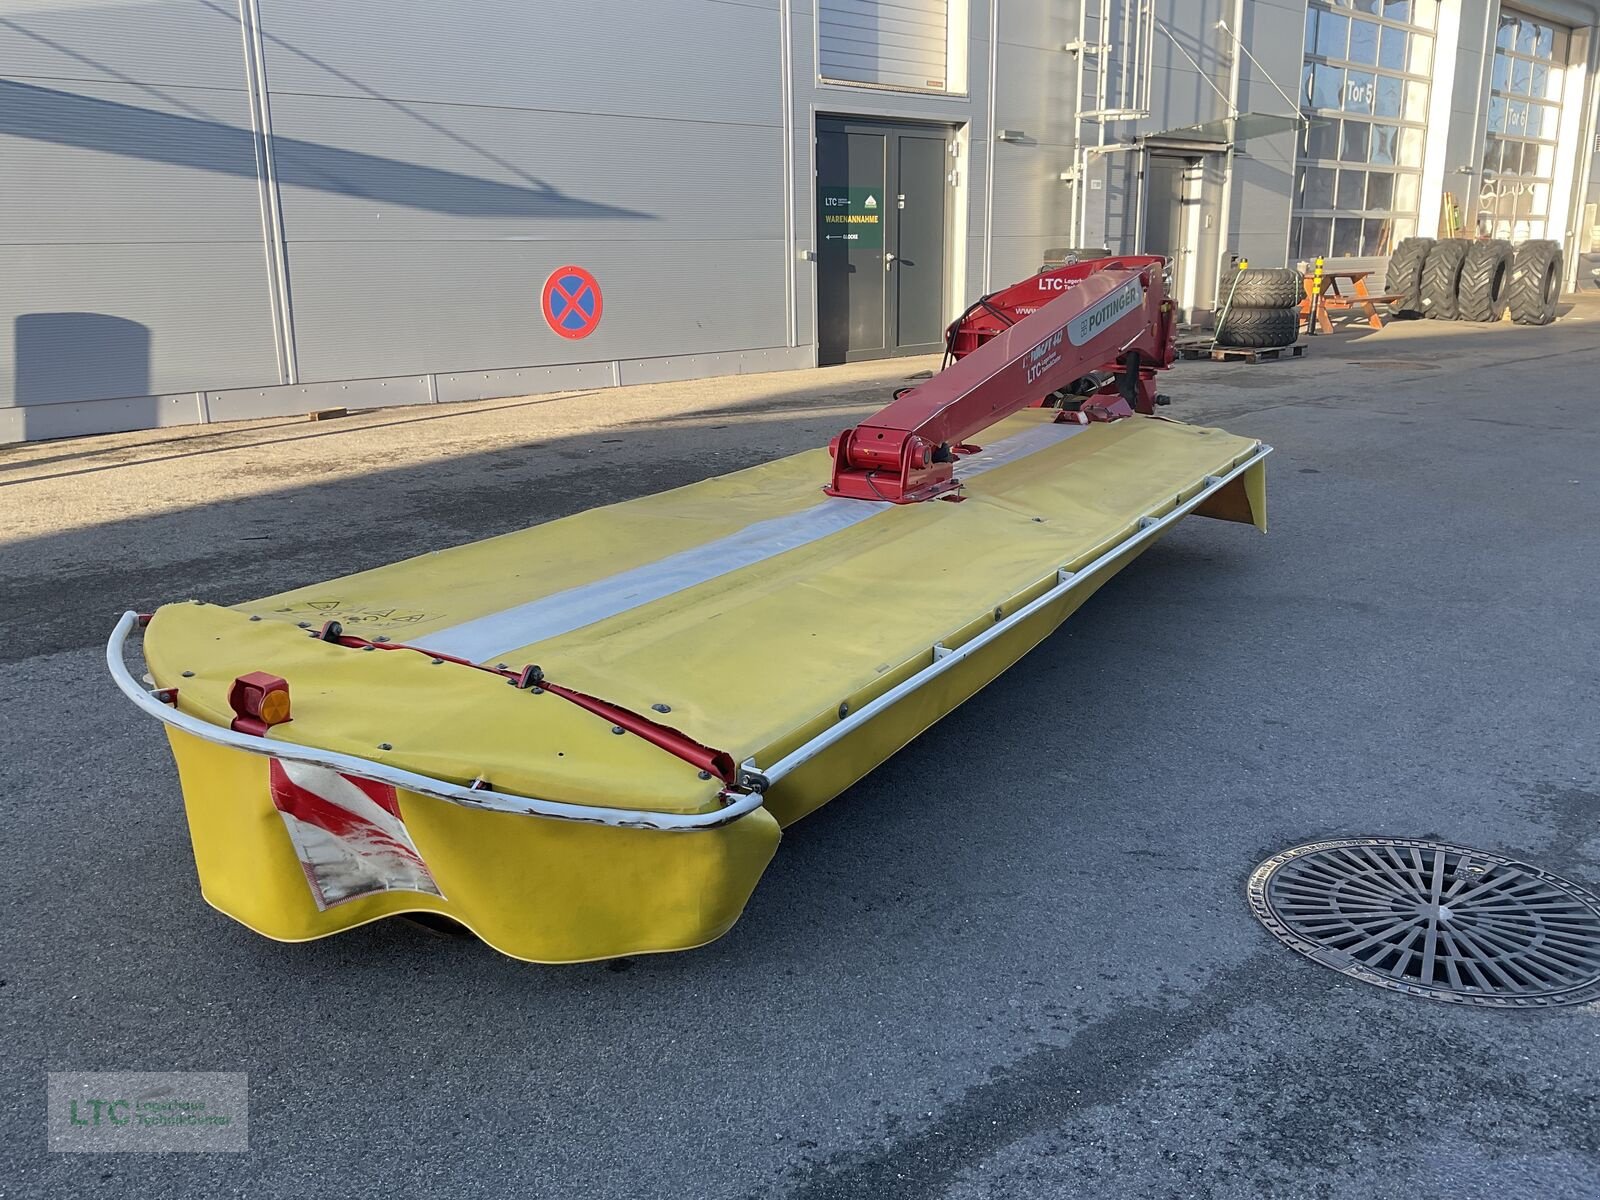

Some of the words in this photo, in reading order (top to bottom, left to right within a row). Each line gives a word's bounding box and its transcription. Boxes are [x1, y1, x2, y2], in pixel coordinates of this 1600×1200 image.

[1348, 80, 1365, 102] Tor
[1365, 84, 1373, 103] 5
[1507, 108, 1519, 126] Tor
[1519, 112, 1526, 127] 6
[825, 197, 837, 206] LTC
[825, 215, 879, 223] WARENANNAHME
[1039, 278, 1062, 290] LTC
[1027, 362, 1041, 384] LTC
